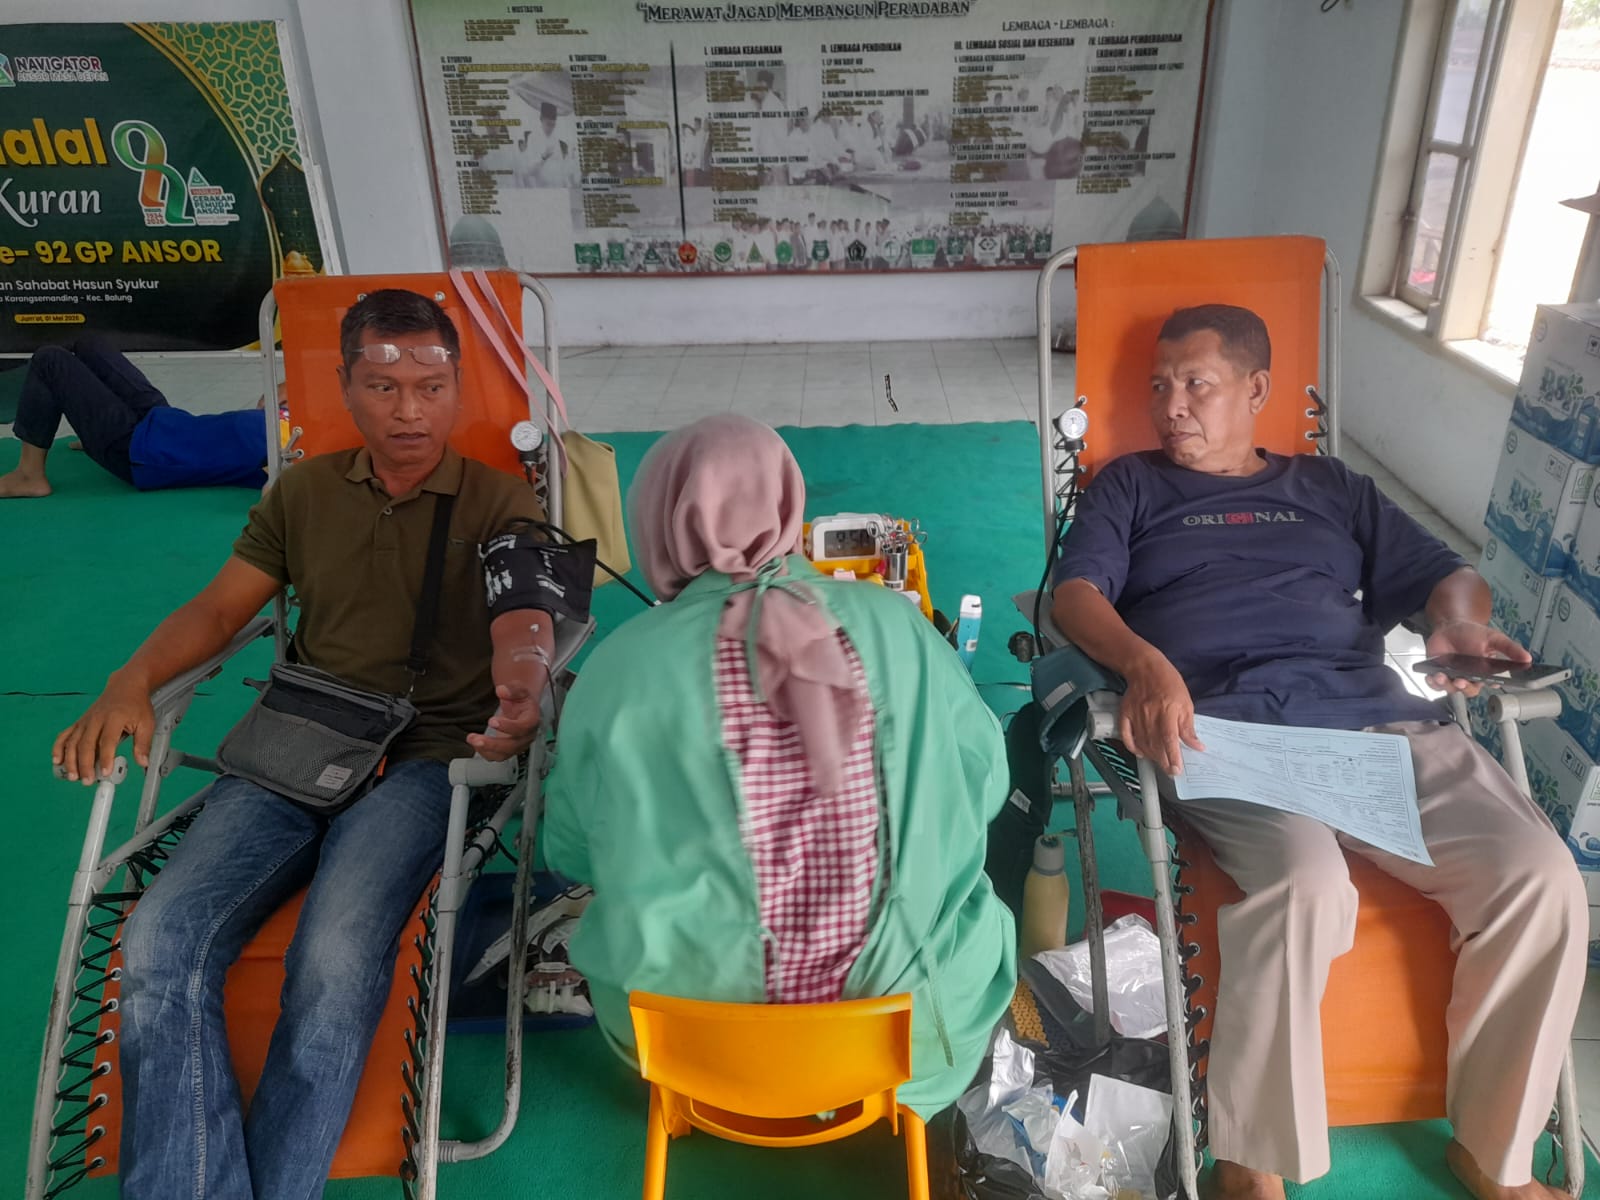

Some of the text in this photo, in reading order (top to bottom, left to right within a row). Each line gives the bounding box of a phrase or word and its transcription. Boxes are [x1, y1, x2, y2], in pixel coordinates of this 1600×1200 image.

[726, 3, 777, 20] JAGAD
[780, 2, 875, 19] MEMBANGUN
[1002, 20, 1051, 31] LEMBAGA
[1060, 18, 1108, 30] LEMBAGA
[966, 40, 996, 49] LEMBAGA
[998, 40, 1020, 48] SOSIAL
[1022, 39, 1035, 47] DAN
[1037, 38, 1074, 47] KESEHATAN
[1097, 36, 1129, 45] LEMBAGA
[711, 46, 741, 55] LEMBAGA
[830, 44, 860, 52] LEMBAGA
[16, 57, 102, 71] NAVIGATOR
[35, 240, 72, 263] 92
[75, 241, 113, 263] GP
[122, 239, 223, 263] ANSOR
[15, 279, 70, 290] Sahabat
[73, 279, 113, 289] Hasun
[115, 278, 159, 292] Syukur
